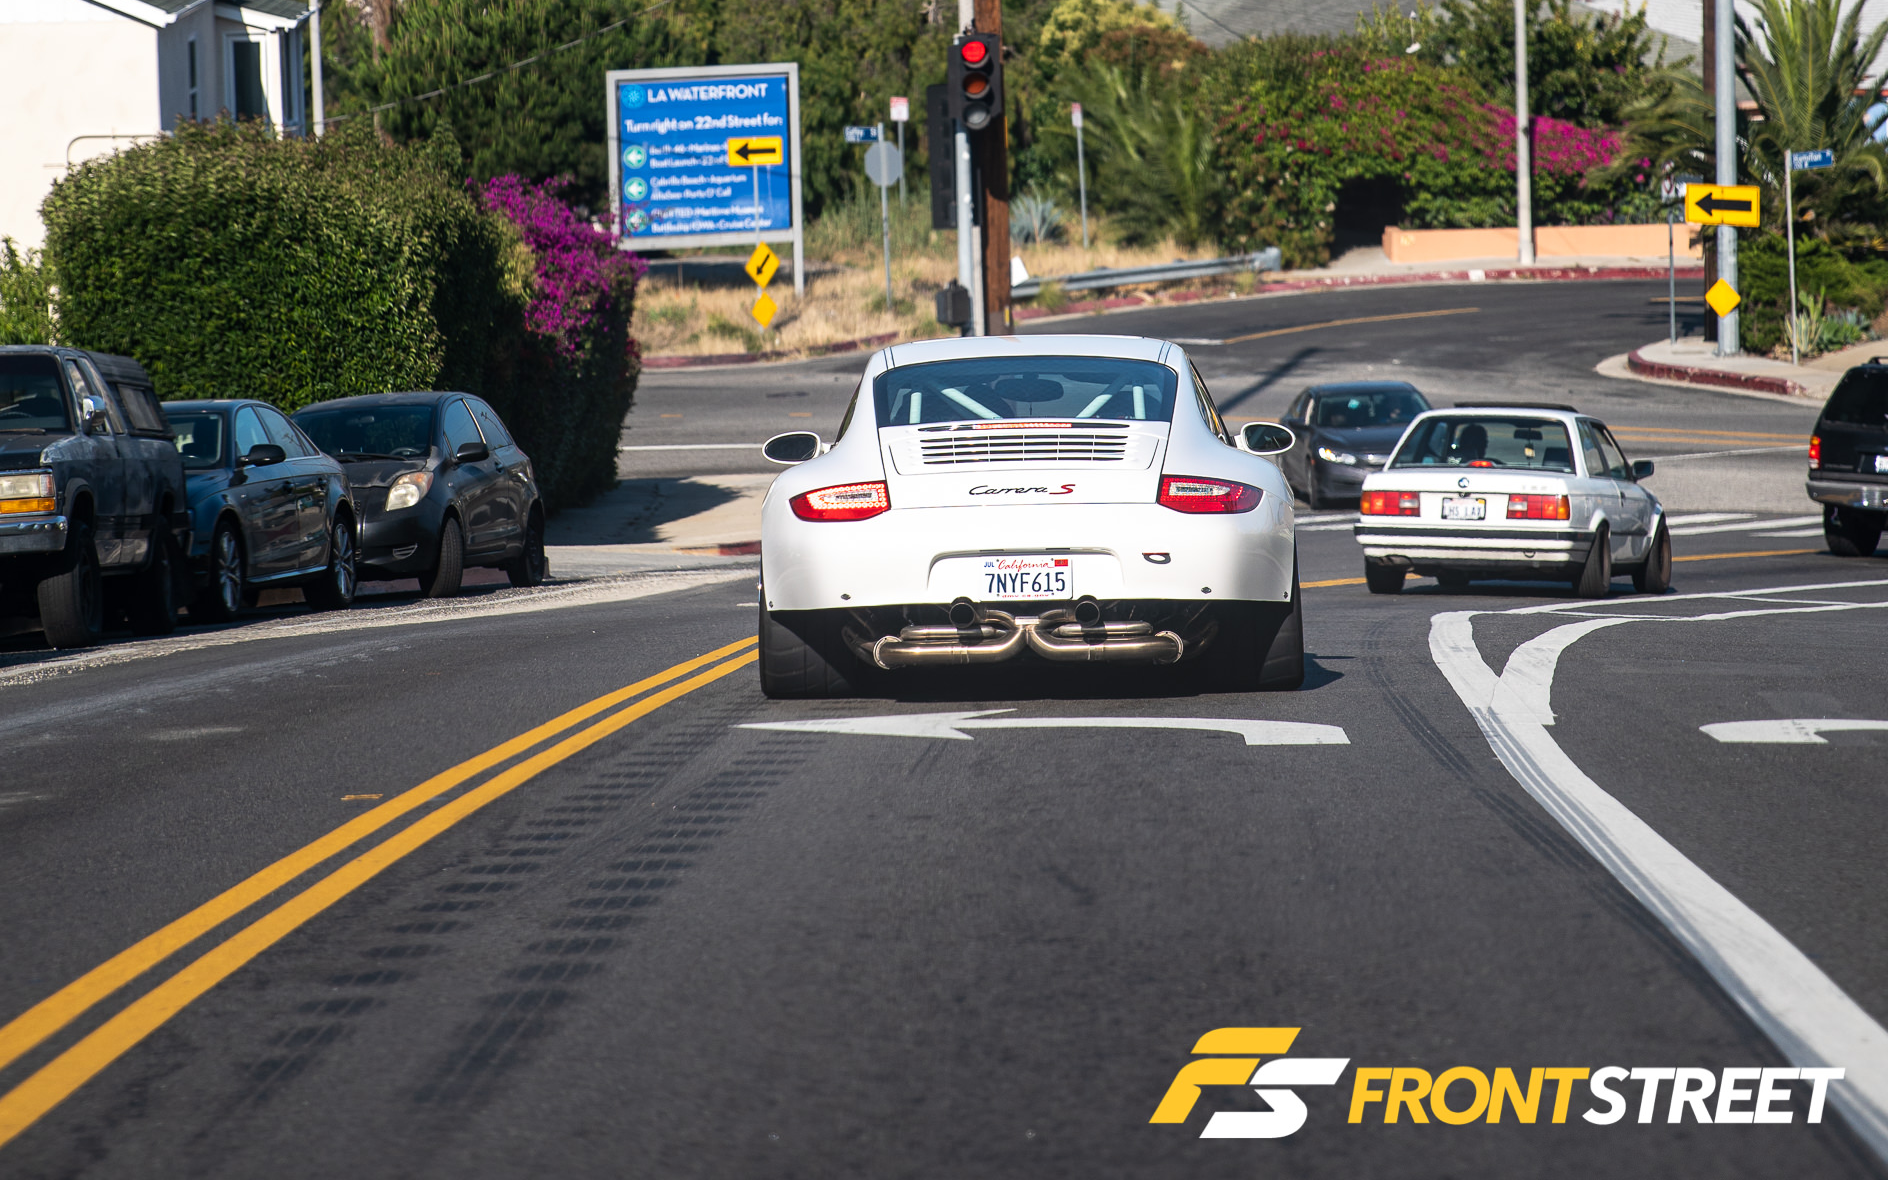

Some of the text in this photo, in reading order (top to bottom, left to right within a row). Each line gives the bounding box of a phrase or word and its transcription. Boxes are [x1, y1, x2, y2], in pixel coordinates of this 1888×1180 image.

[647, 83, 768, 103] LA WATERFRONT
[624, 118, 648, 133] Turn
[648, 117, 677, 135] right
[678, 120, 694, 131] on
[694, 114, 727, 130] 22nd
[727, 113, 763, 129] Street
[969, 484, 1076, 496] Carrera S
[998, 559, 1051, 572] California
[985, 572, 1066, 593] 7NYF615
